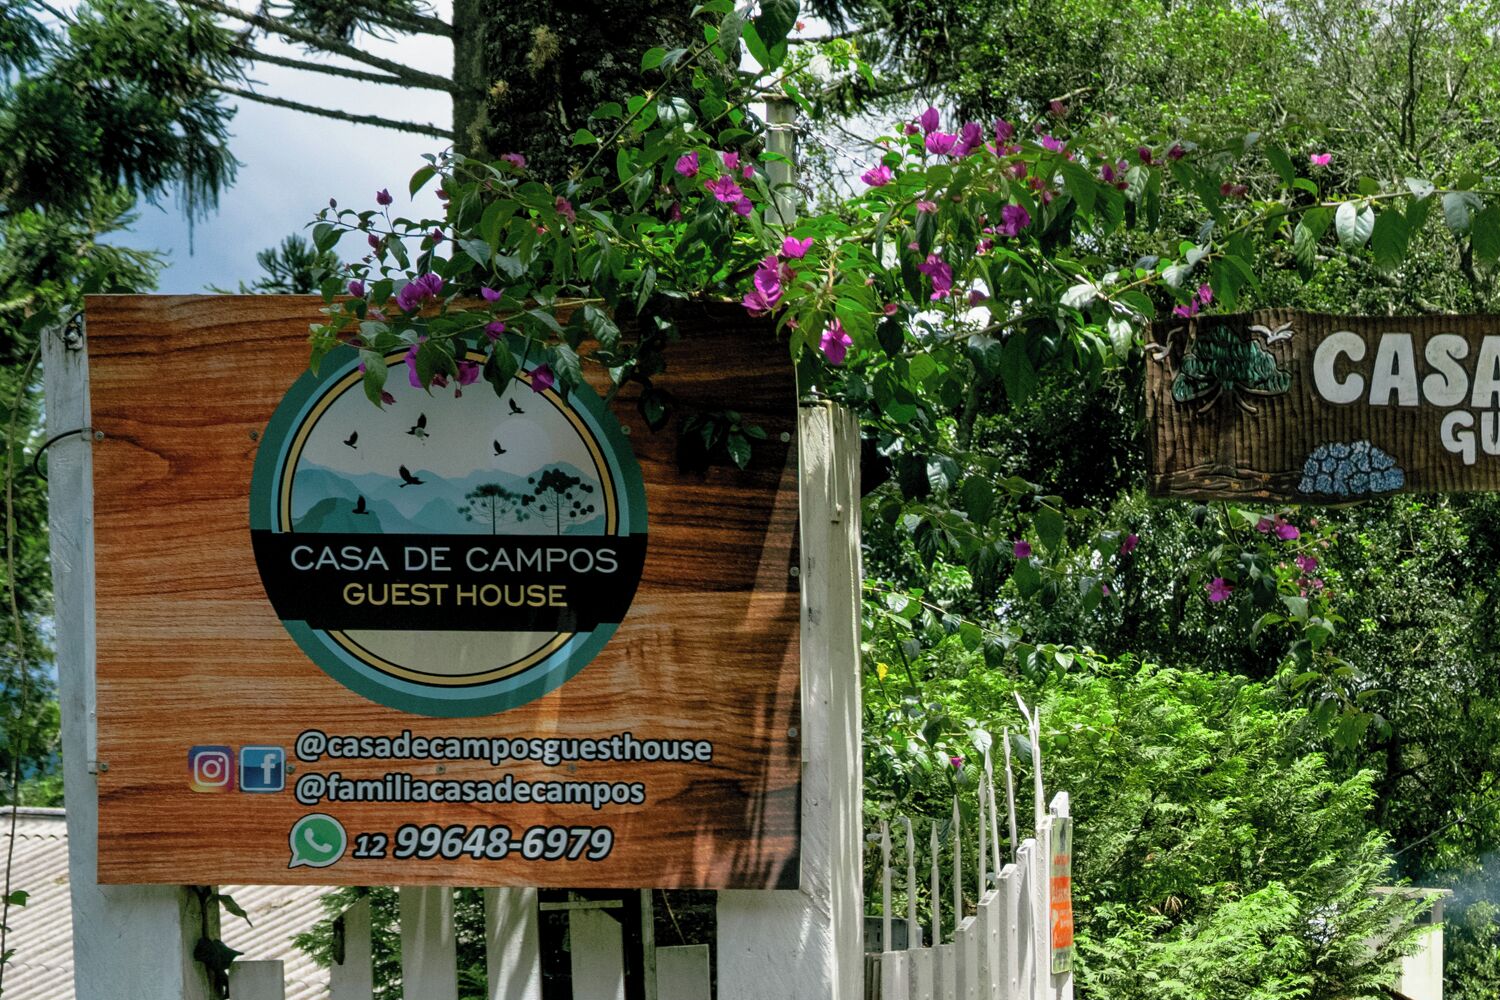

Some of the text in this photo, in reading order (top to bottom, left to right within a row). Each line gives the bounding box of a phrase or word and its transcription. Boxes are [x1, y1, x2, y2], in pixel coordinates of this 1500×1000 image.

[290, 545, 619, 574] CASA DE CAMPOS
[342, 582, 568, 608] GUEST HOUSE
[294, 729, 713, 765] @casadecamposguesthouse
[294, 772, 646, 809] @familiacasadecampos
[353, 823, 614, 861] 12 99648-6979
